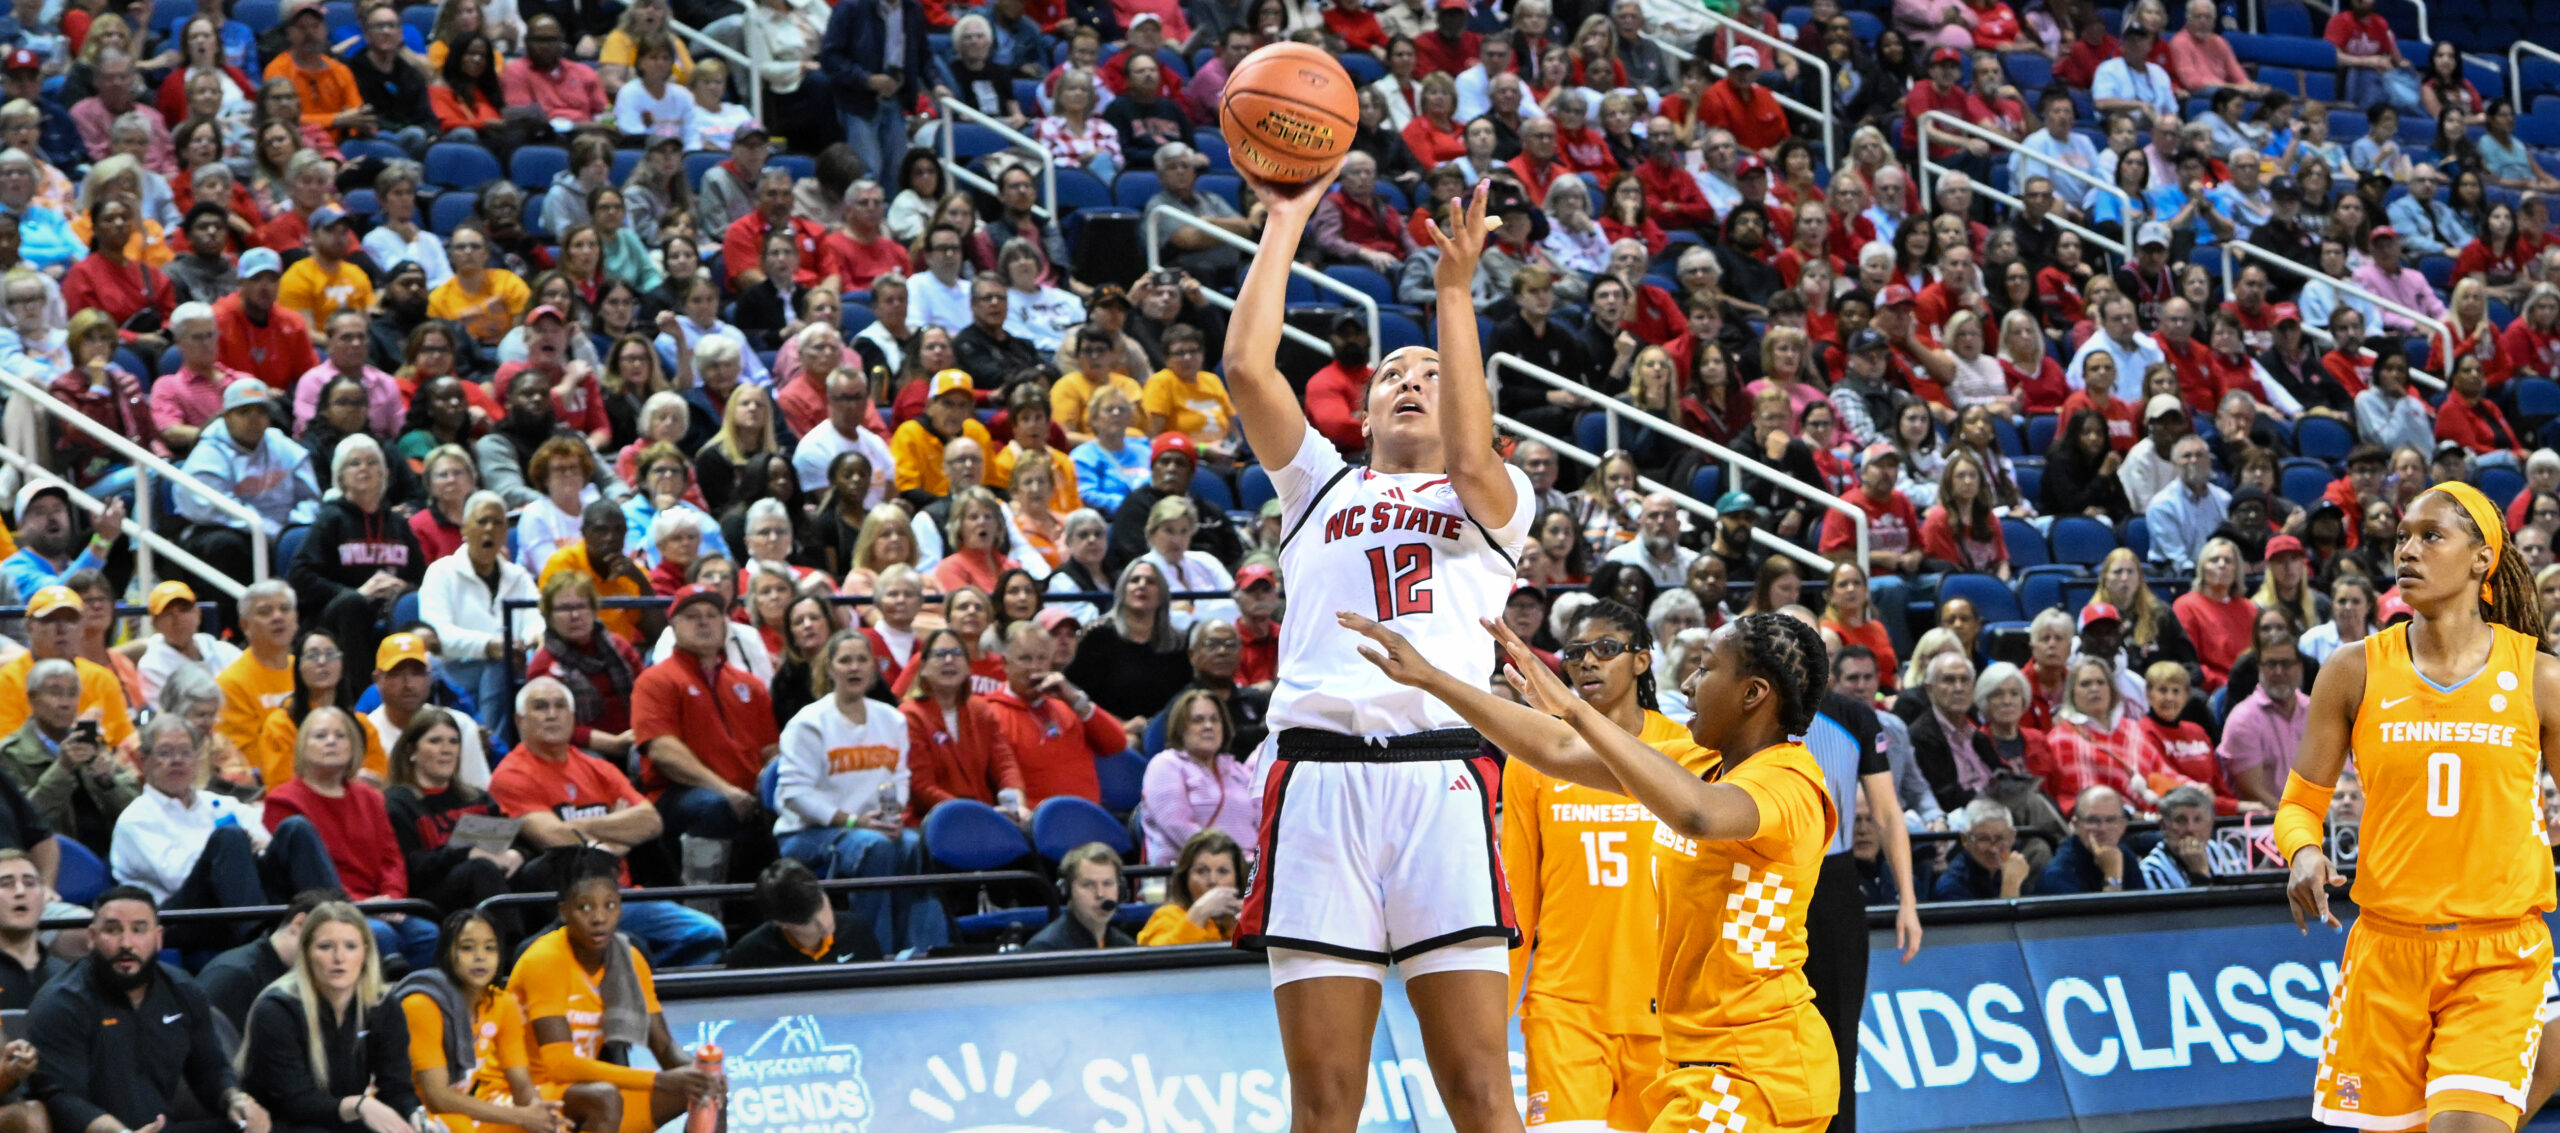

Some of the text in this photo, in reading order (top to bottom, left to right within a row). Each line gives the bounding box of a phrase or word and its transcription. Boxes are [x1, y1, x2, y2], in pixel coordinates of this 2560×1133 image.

[1325, 502, 1465, 544] NC STATE
[1364, 542, 1433, 622] 12
[2379, 721, 2517, 747] TENNESSEE
[2426, 752, 2461, 817] 0
[1580, 831, 1629, 887] 15
[726, 1079, 866, 1127] GENDS
